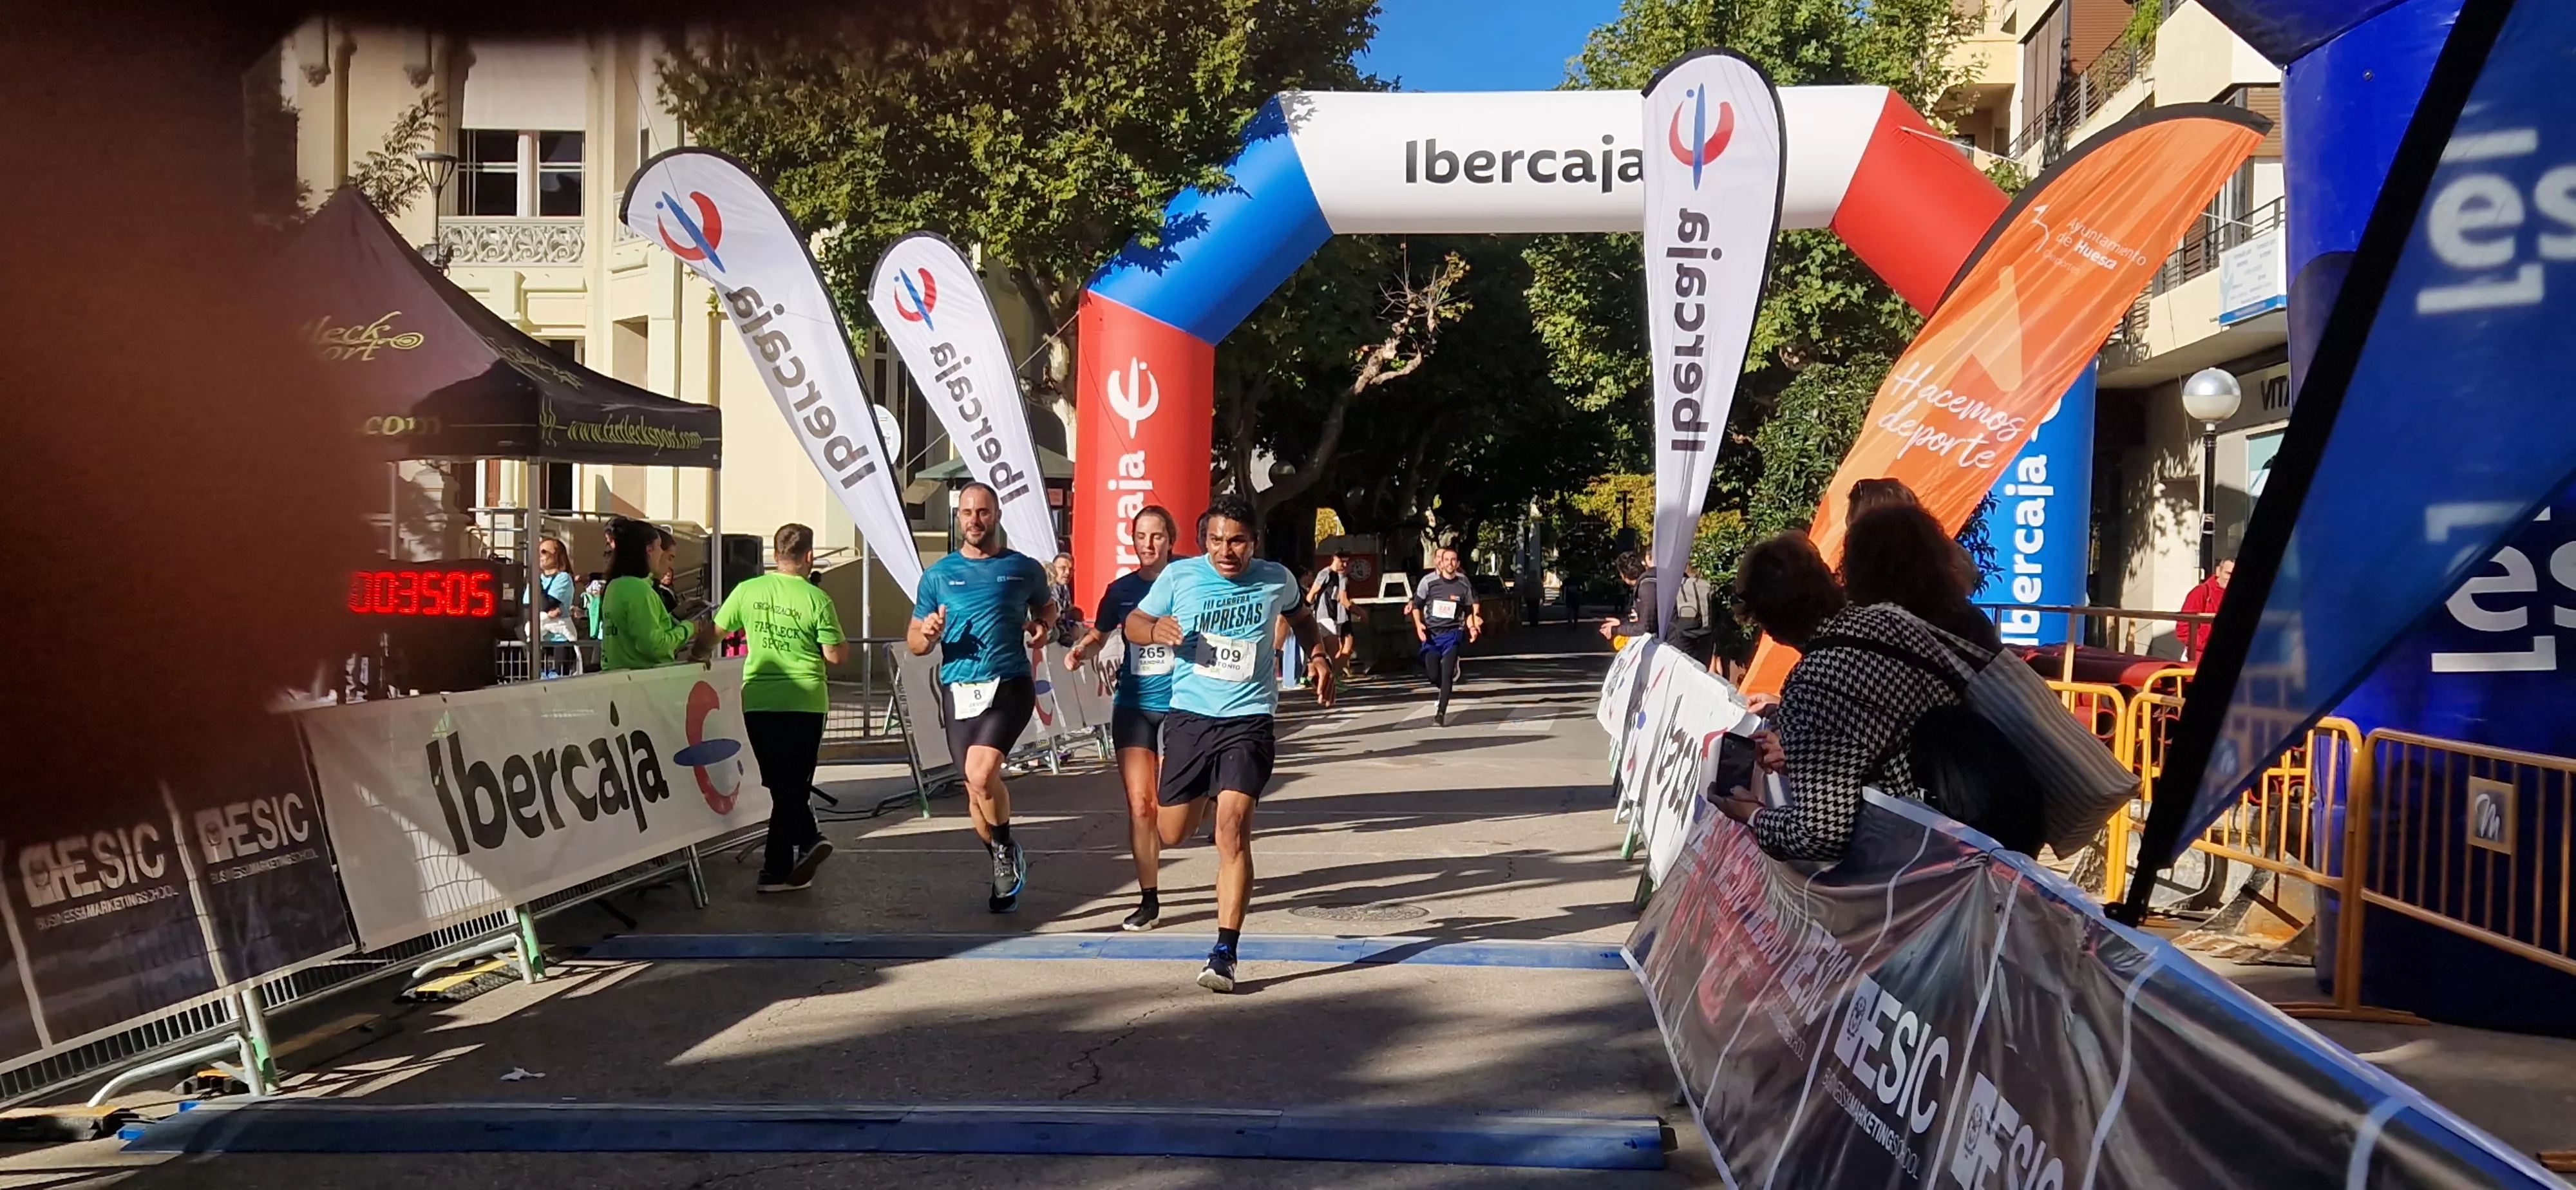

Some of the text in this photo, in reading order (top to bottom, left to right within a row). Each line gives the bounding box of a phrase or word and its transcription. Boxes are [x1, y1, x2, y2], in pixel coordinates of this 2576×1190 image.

[1406, 134, 1643, 194] Ibercaja
[2056, 231, 2118, 270] de Huesca
[2067, 217, 2146, 266] Ayuntamento
[1890, 361, 2026, 442] Hacemos
[1877, 399, 1997, 469] deporte
[1108, 450, 1153, 580] rcaja
[2000, 453, 2054, 646] Ibercaja
[1193, 602, 1264, 632] EMPRESAS
[1139, 647, 1165, 658] 265
[1211, 647, 1242, 663] 109
[974, 689, 981, 700] 8
[425, 699, 670, 856] Ibercaja
[227, 793, 309, 857] ESIC
[55, 823, 166, 898] ESIC
[1852, 988, 1949, 1134] ESIC
